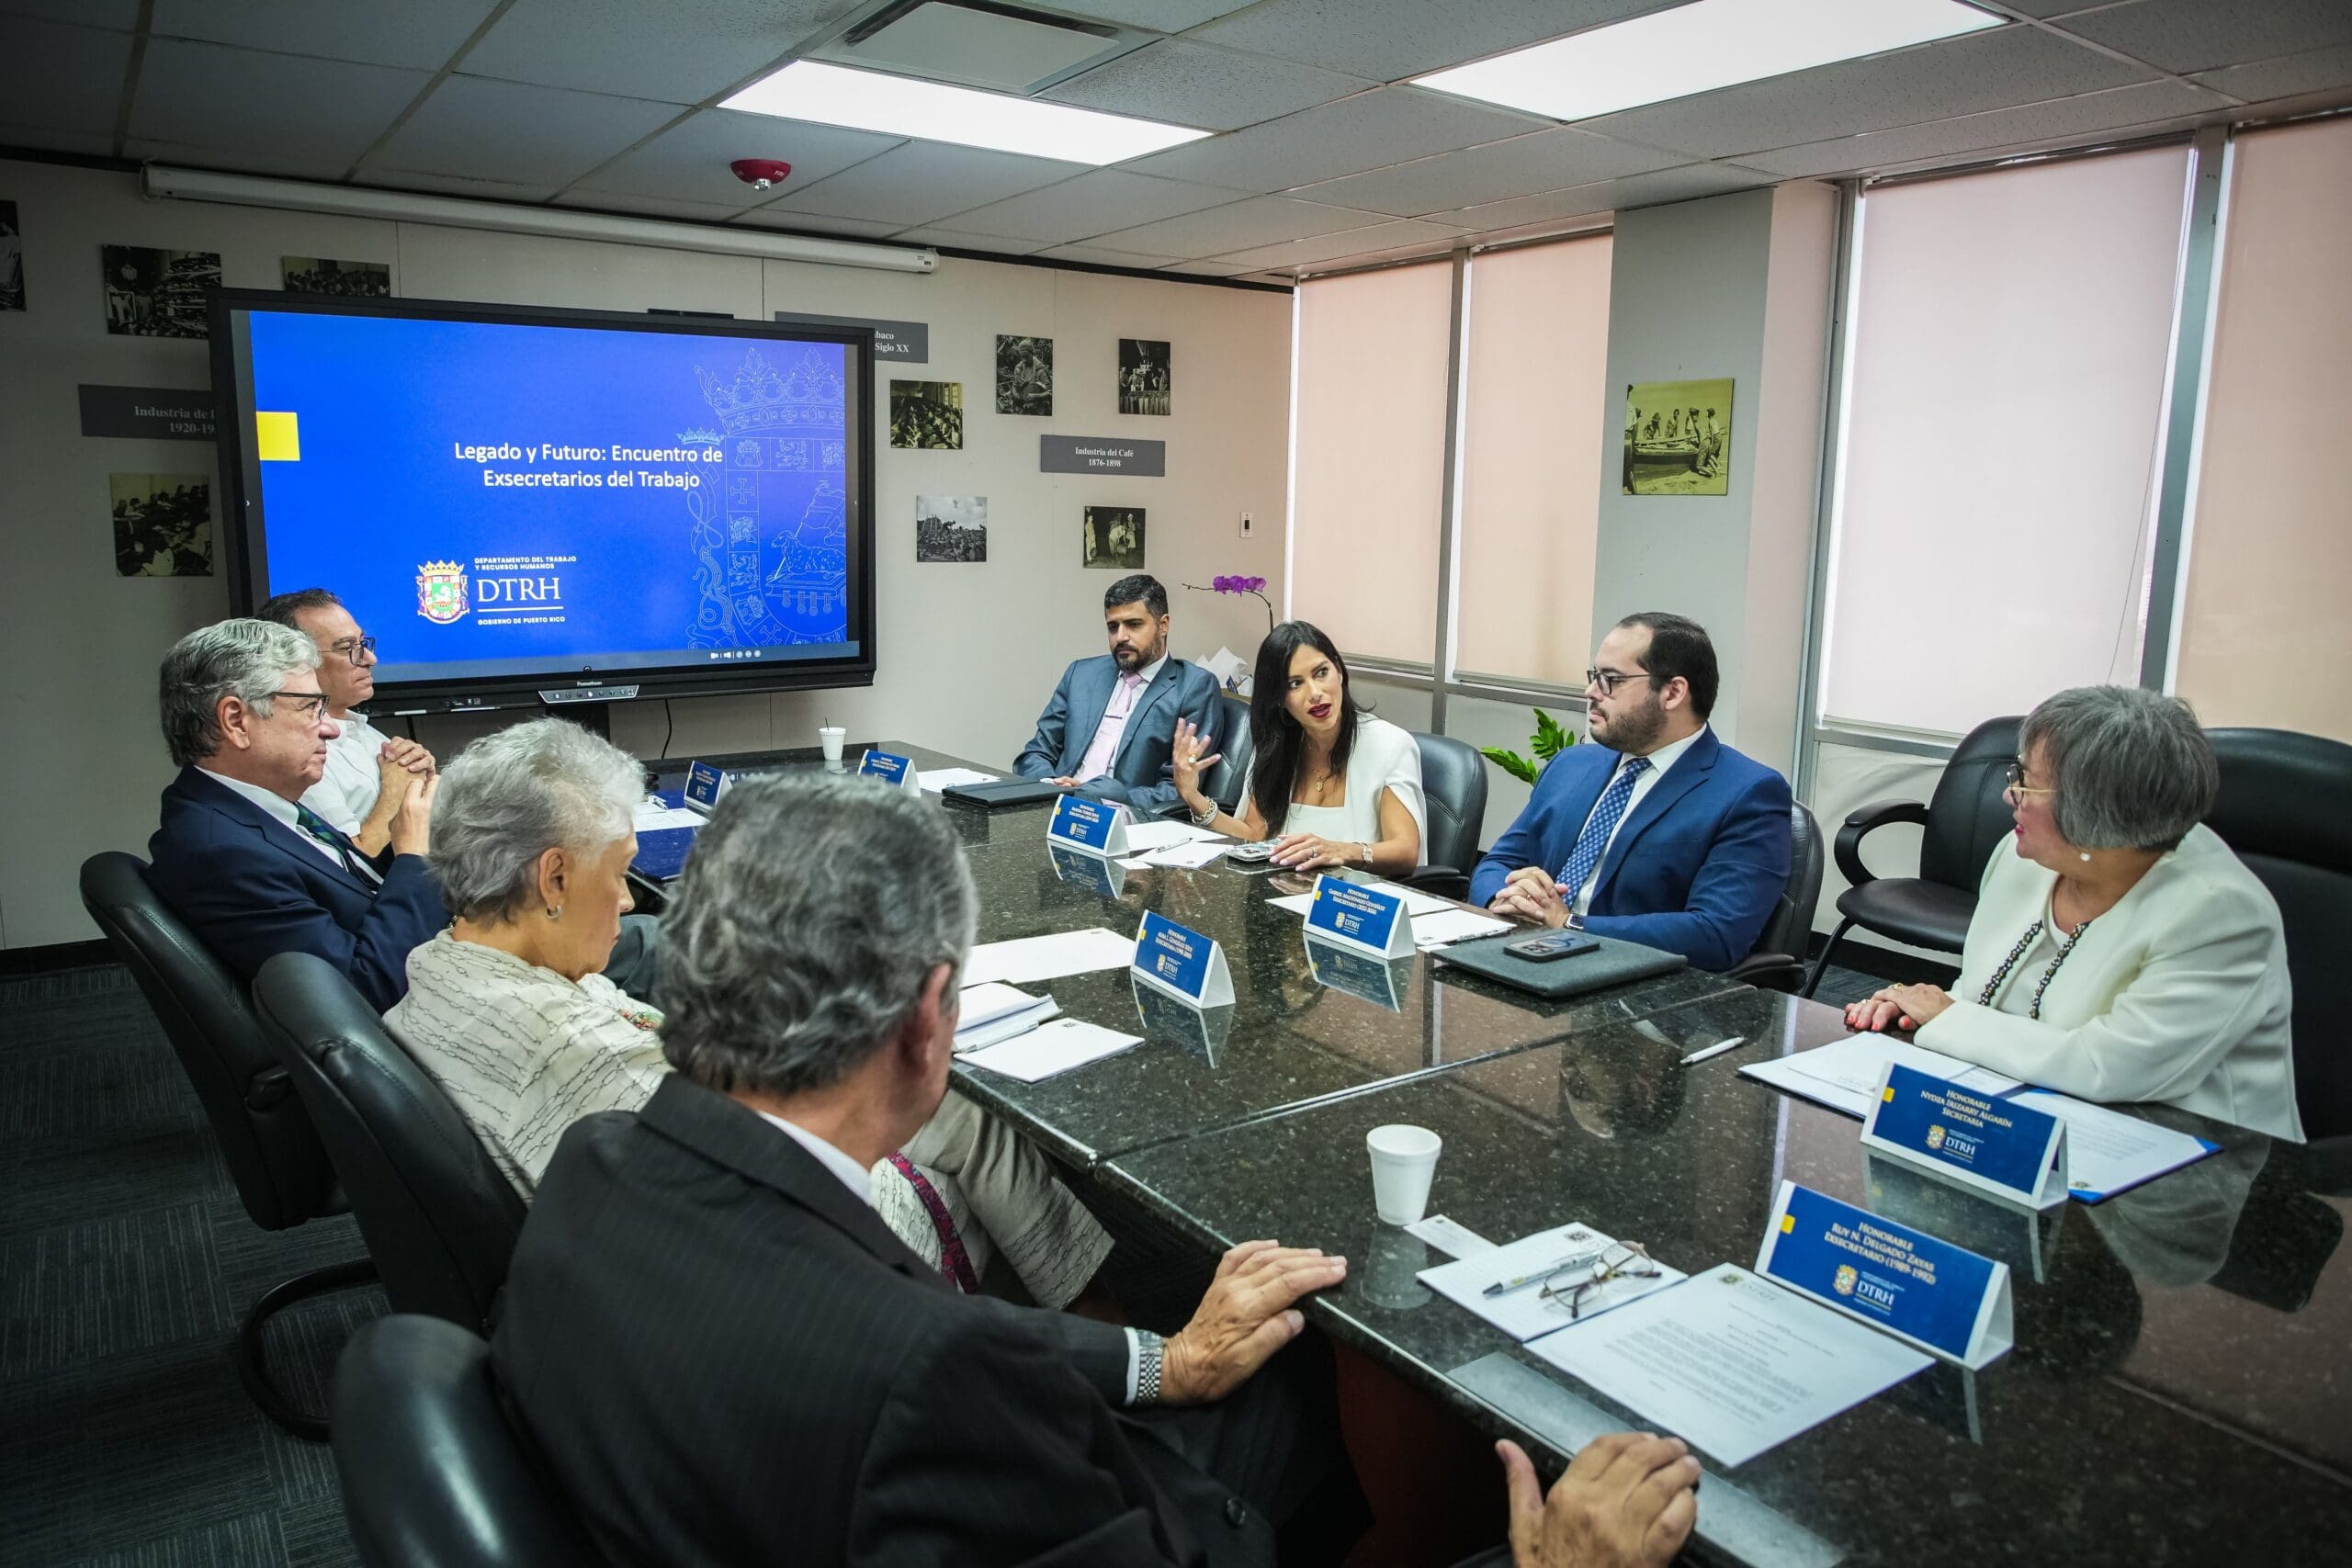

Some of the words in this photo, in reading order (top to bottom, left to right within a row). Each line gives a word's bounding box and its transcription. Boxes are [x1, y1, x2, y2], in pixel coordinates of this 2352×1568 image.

[874, 331, 895, 340] baco
[875, 343, 895, 354] Siglo
[896, 344, 910, 353] XX
[134, 405, 191, 419] Industria
[194, 409, 208, 419] de
[169, 422, 216, 434] 1920-19
[455, 442, 522, 464] Legado
[526, 446, 537, 464] y
[542, 443, 606, 461] Futuro:
[612, 445, 698, 462] Encuentro
[702, 446, 724, 462] de
[1075, 446, 1106, 457] Industria
[1107, 448, 1117, 457] del
[1118, 447, 1135, 457] Café
[1088, 458, 1122, 468] 1876-1898
[483, 468, 603, 488] Exsecretarios
[607, 469, 634, 488] del
[638, 470, 700, 491] Trabajo
[545, 555, 577, 563] TRABAJO
[474, 563, 480, 571] Y
[520, 562, 555, 570] HUMANOS
[476, 577, 561, 603] DTRH
[478, 617, 512, 626] GOBIERNO
[1945, 1136, 1976, 1156] DTRH
[1857, 1280, 1894, 1306] DTRH
